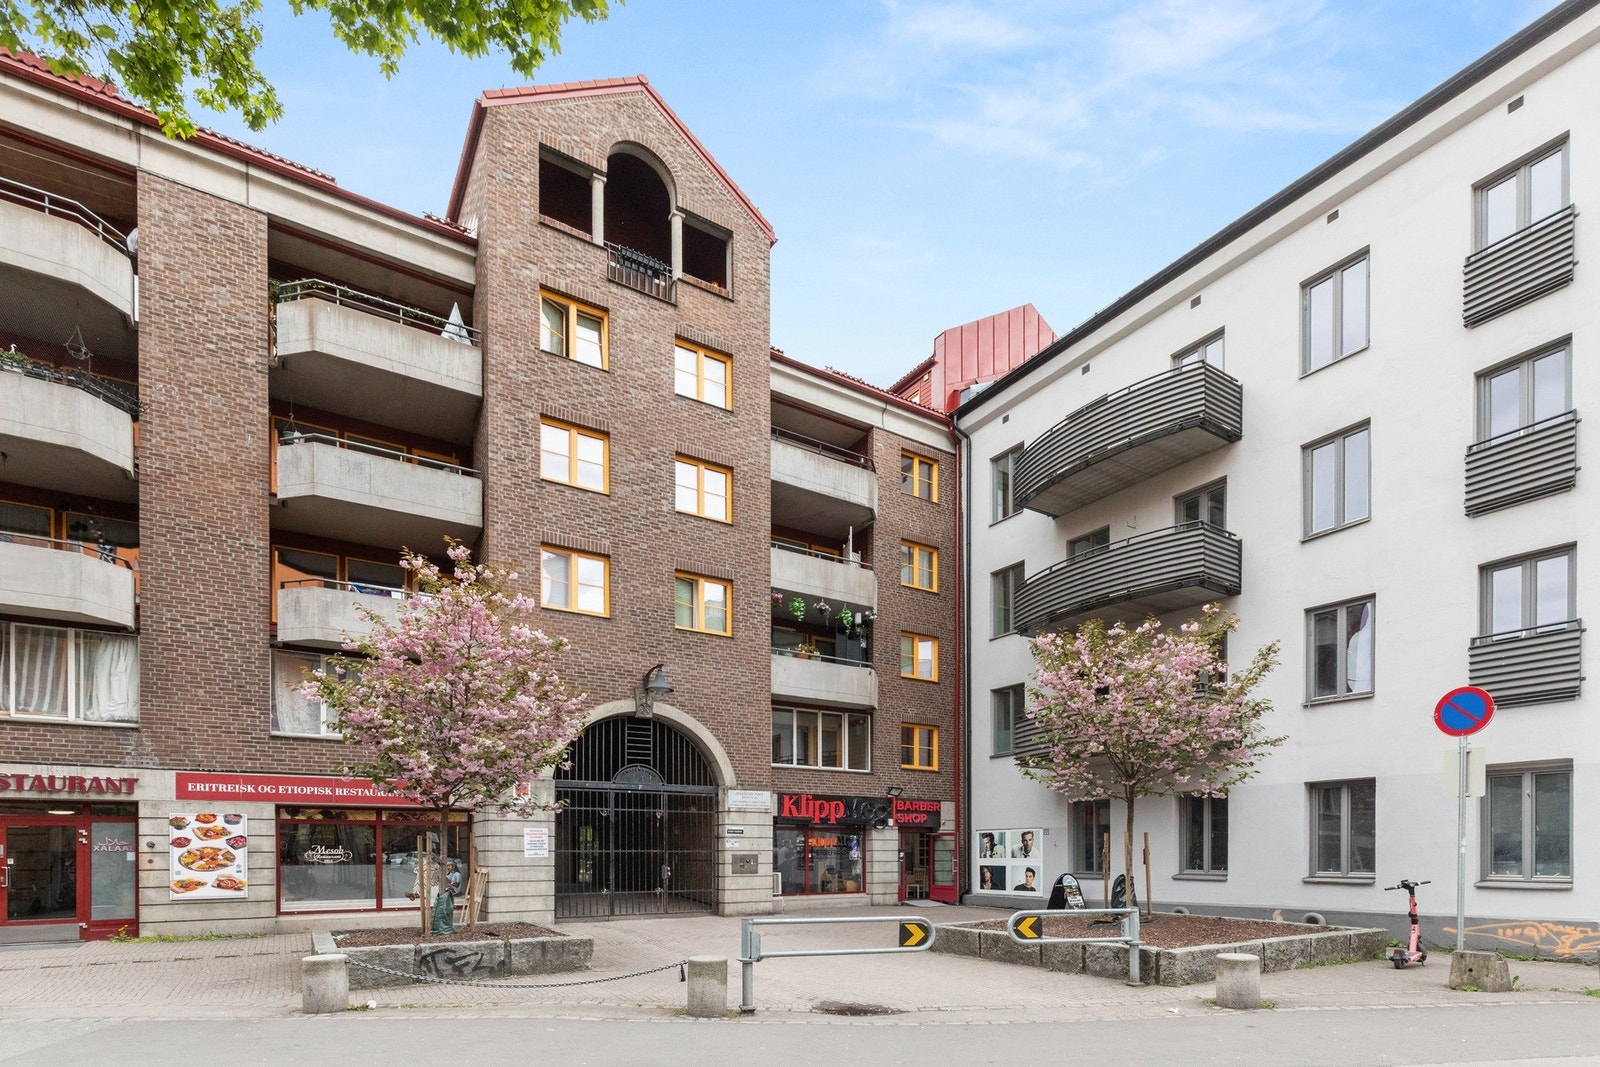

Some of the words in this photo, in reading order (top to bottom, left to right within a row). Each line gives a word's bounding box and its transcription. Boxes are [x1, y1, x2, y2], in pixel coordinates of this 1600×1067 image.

[187, 782, 256, 793] ERITREISK
[258, 784, 276, 793] OG
[278, 785, 333, 795] ETIOPISK
[896, 800, 940, 811] BARBER
[896, 813, 928, 824] SHOP
